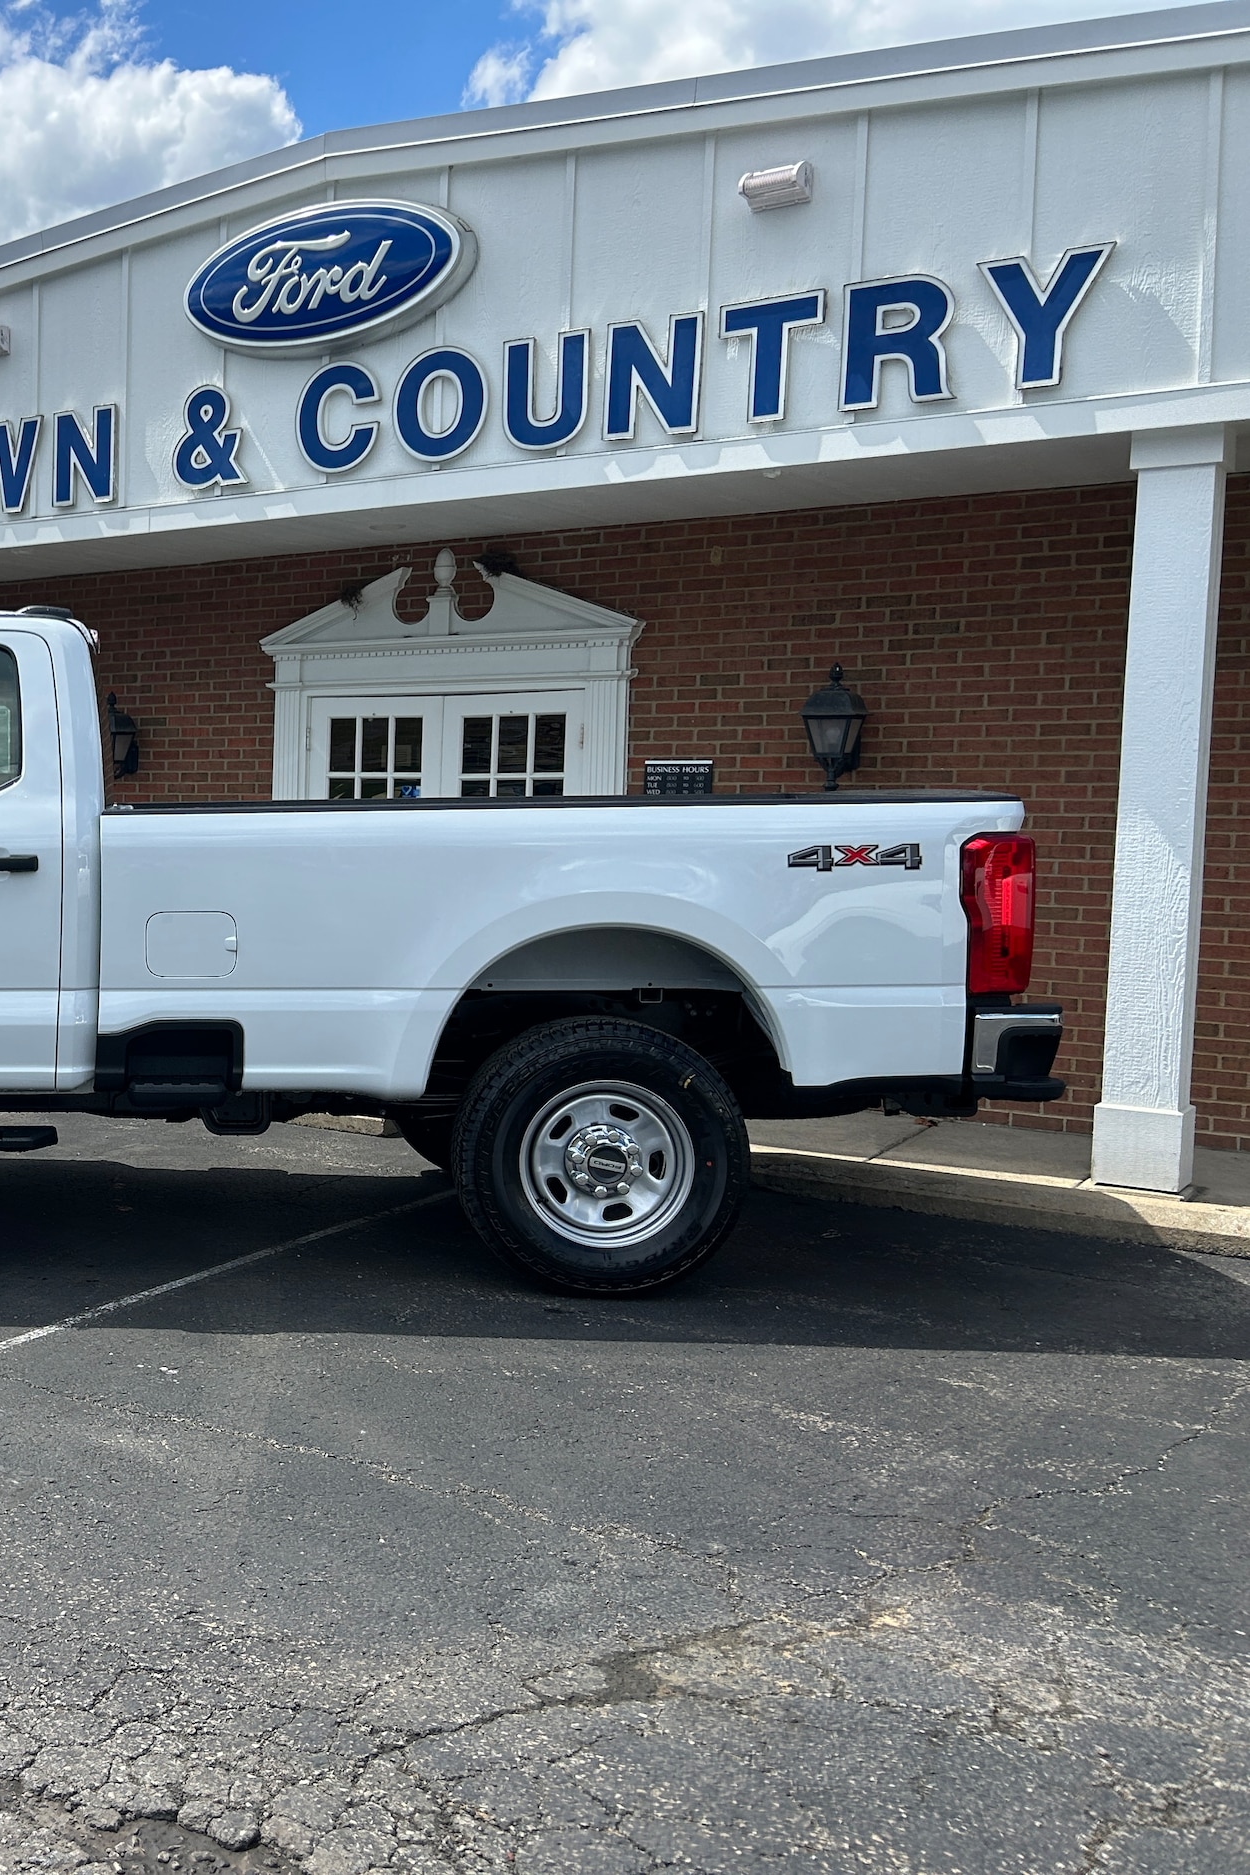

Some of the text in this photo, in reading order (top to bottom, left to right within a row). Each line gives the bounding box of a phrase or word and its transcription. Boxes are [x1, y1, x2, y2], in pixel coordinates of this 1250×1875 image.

[233, 229, 393, 323] Ford
[172, 384, 249, 490] &
[295, 241, 1117, 474] COUNTRY
[646, 766, 710, 774] BUSINESS HOURS
[594, 1160, 622, 1170] FORD
